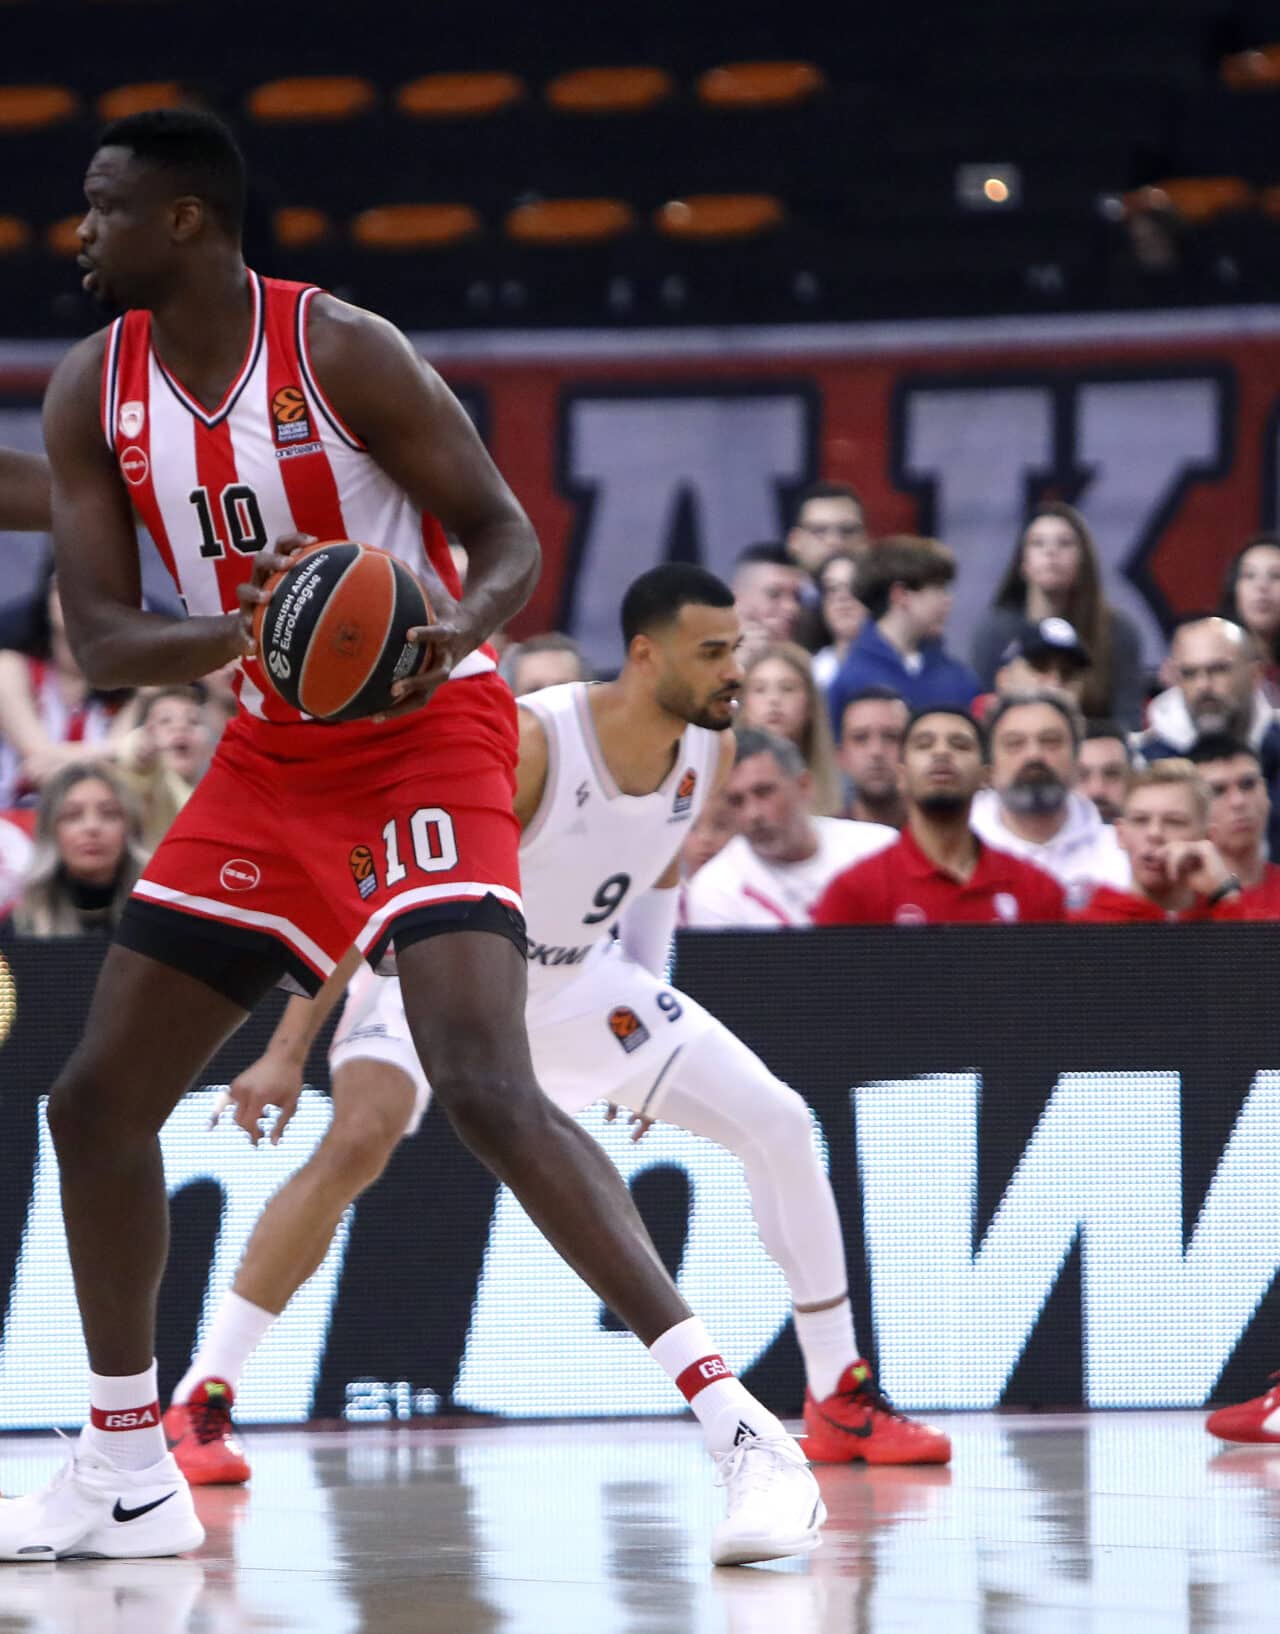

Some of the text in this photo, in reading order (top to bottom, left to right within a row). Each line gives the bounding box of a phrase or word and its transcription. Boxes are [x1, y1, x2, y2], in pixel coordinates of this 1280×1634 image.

[189, 484, 268, 559] 10
[272, 553, 330, 646] TURKISH AIRLINES
[280, 573, 322, 651] EuroLeague
[381, 806, 460, 888] 10
[581, 872, 632, 925] 9
[656, 991, 684, 1023] 9
[698, 1359, 732, 1379] GS
[105, 1410, 155, 1428] GSA
